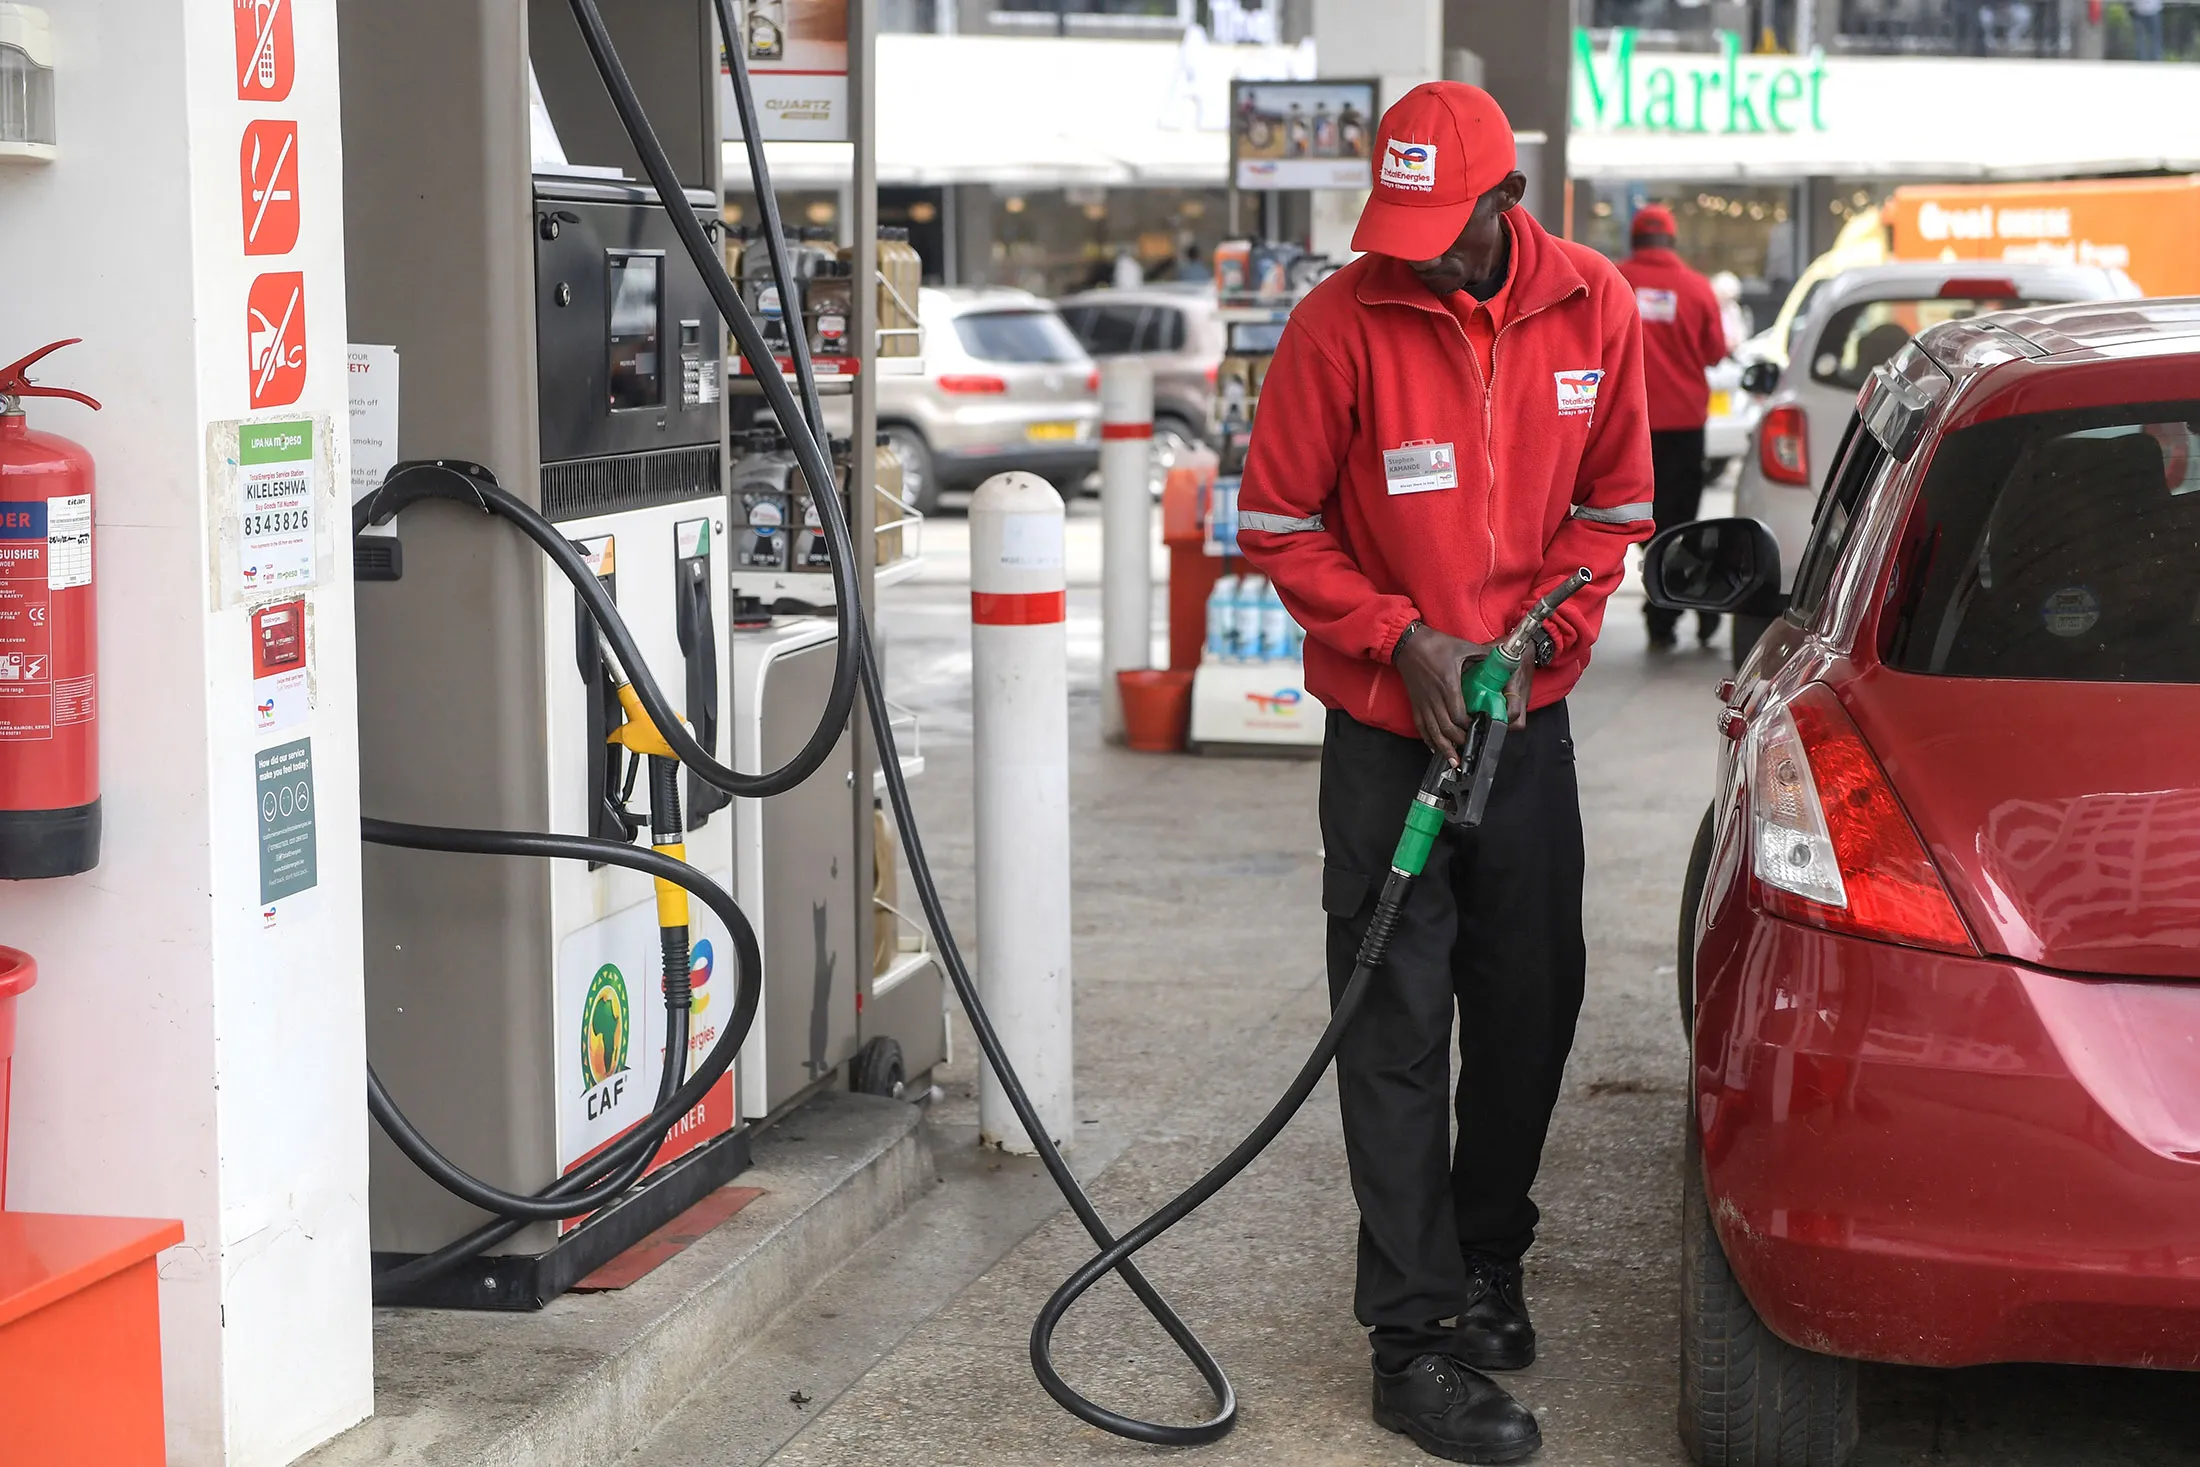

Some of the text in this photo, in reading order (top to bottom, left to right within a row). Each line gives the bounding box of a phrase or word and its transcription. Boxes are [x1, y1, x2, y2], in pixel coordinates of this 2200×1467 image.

[1571, 25, 1830, 134] Market
[765, 99, 832, 111] QUARTZ
[1384, 168, 1430, 182] TotalEnergies
[347, 364, 370, 373] ETY
[352, 438, 383, 447] smoking
[1388, 457, 1414, 465] Stephen
[276, 470, 290, 479] Service
[291, 469, 304, 477] Station
[350, 468, 377, 476] itch off
[366, 479, 384, 487] phon
[246, 479, 307, 499] KILELESHWA
[255, 503, 263, 511] Buy
[264, 502, 276, 510] Goods
[245, 510, 308, 536] 8343826
[11, 655, 20, 664] C
[259, 748, 305, 769] How did our service
[259, 759, 309, 781] make you feel today?
[588, 1079, 624, 1121] CAF
